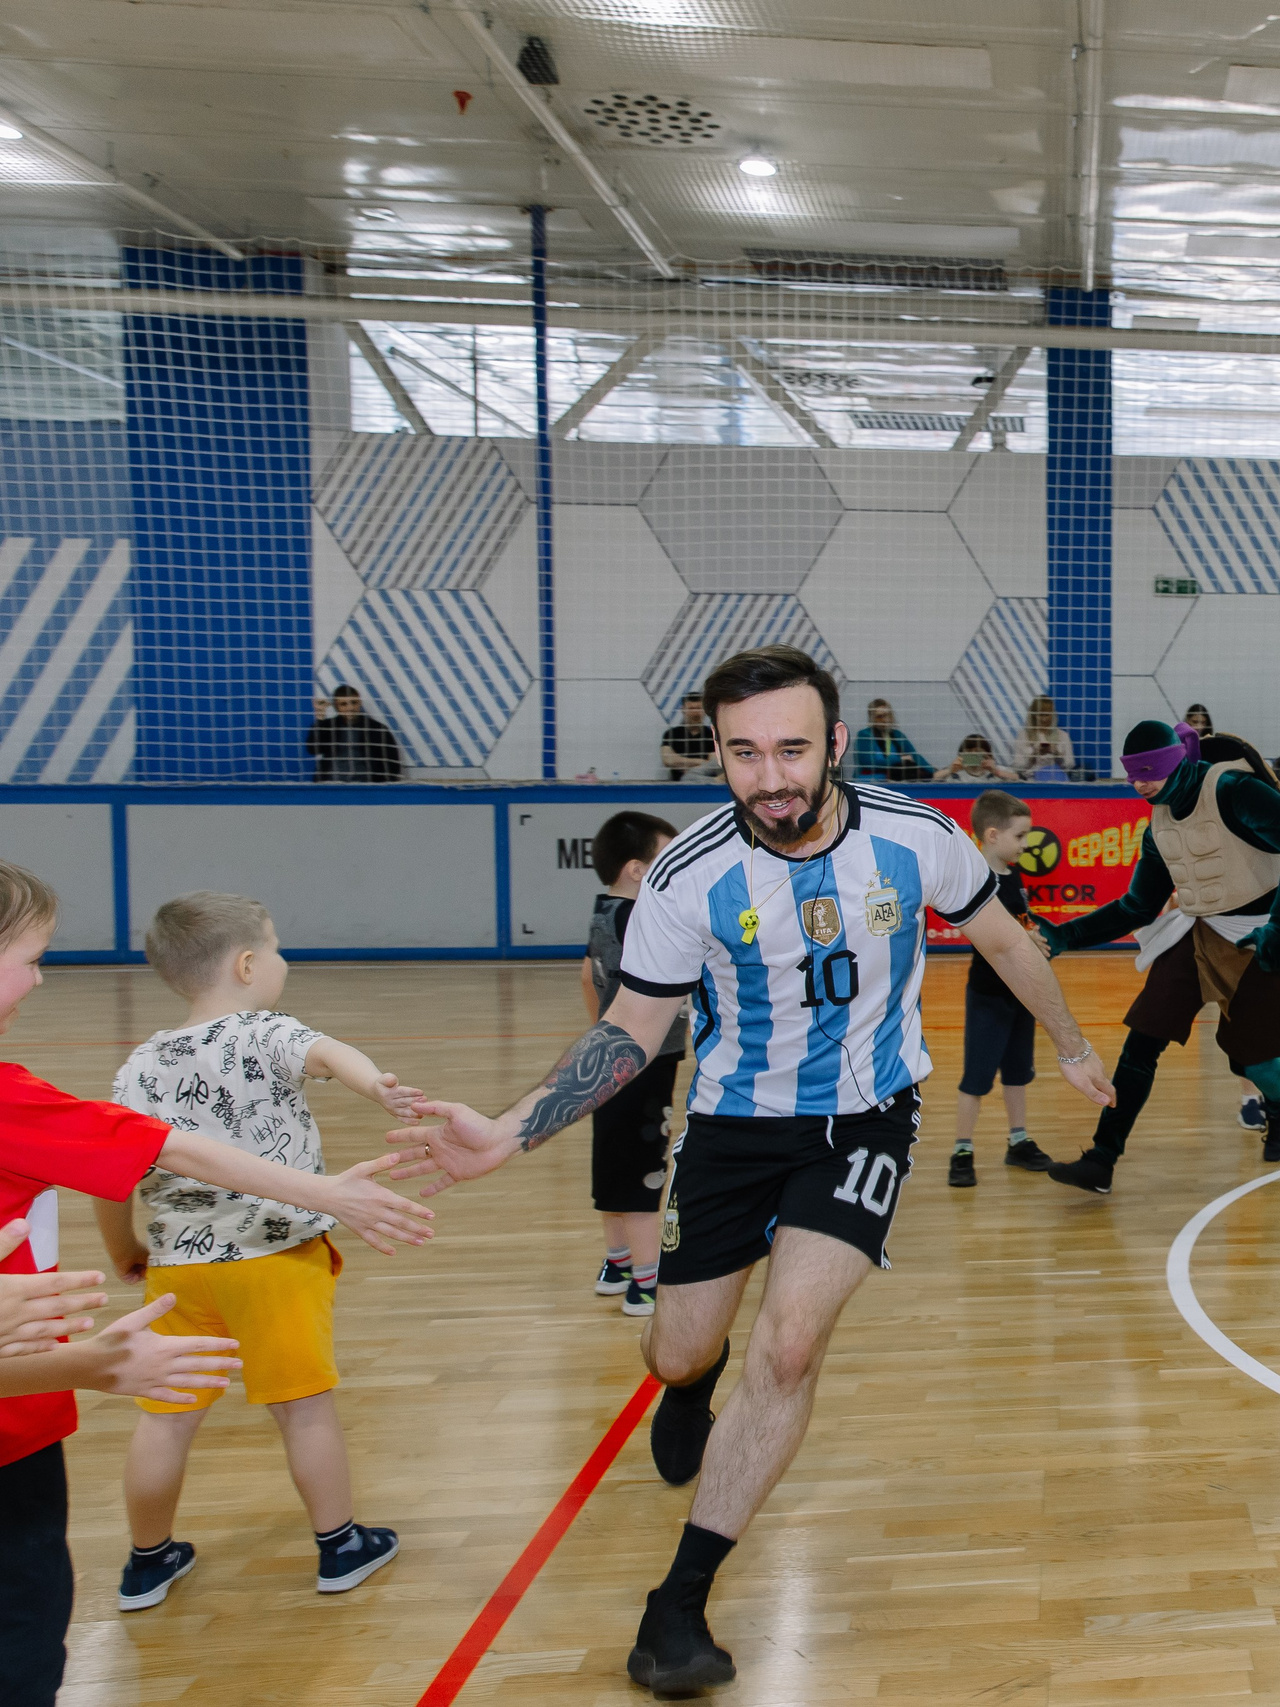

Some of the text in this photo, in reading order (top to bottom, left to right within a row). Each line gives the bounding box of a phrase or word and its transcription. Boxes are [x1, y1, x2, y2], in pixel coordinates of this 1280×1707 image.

[557, 838, 594, 869] МЕ
[1068, 816, 1149, 867] СЕРВИ
[1027, 884, 1096, 902] KTOR
[873, 901, 896, 923] AFA
[815, 927, 834, 936] FIFA
[796, 949, 860, 1009] 10
[833, 1146, 898, 1217] 10
